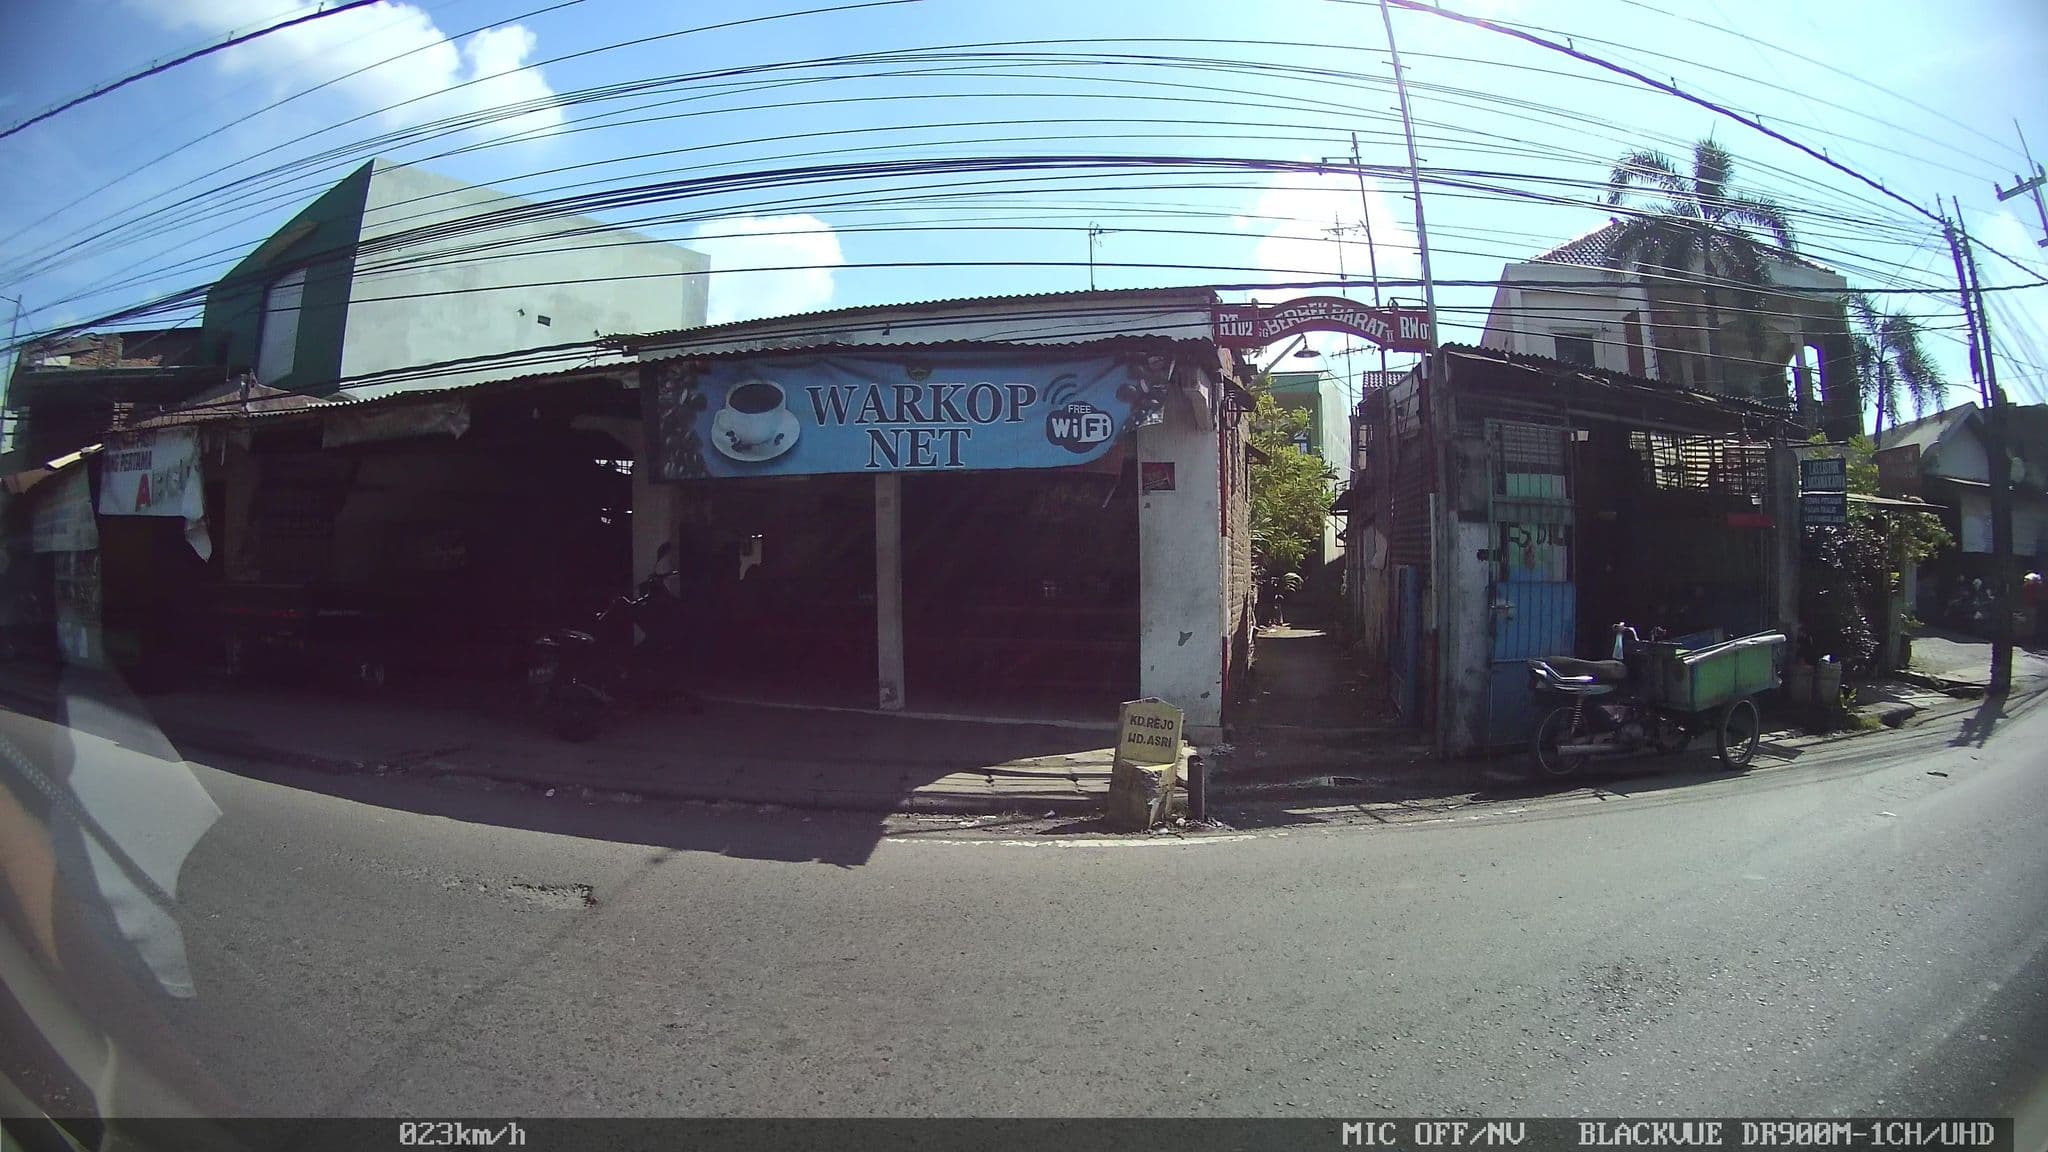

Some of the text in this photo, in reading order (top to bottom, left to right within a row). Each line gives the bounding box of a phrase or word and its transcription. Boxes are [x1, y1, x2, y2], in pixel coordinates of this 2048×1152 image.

[1331, 304, 1388, 338] BARAT
[1400, 316, 1419, 339] RW
[805, 383, 1037, 426] WARKOP
[1068, 404, 1091, 414] FREE
[1051, 416, 1110, 440] WiFi
[865, 427, 971, 470] NET
[1129, 714, 1175, 731] KD.REJO
